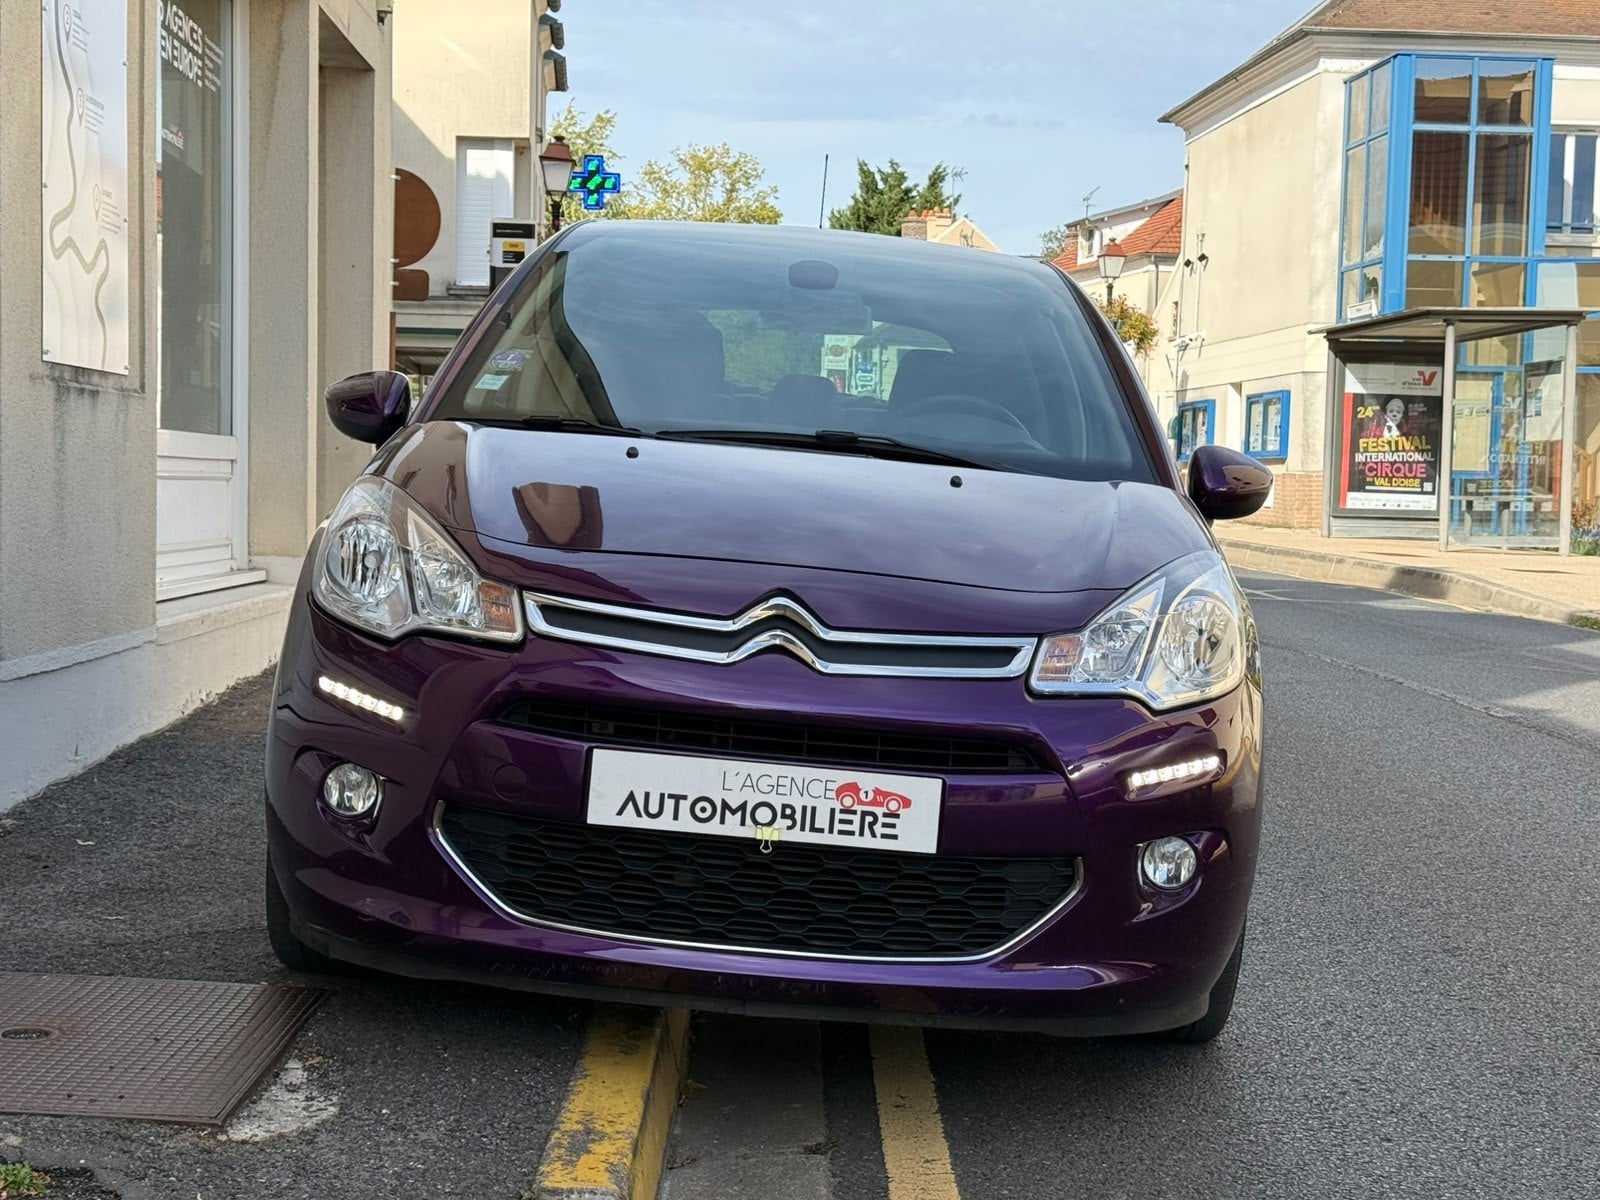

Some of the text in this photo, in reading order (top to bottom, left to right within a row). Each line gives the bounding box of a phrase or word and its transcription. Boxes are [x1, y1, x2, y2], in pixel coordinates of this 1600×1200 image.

[166, 0, 202, 54] AGENCES
[160, 27, 172, 63] EN
[173, 39, 202, 88] EUROPE
[1359, 435, 1431, 452] FESTIVAL
[1354, 452, 1434, 462] INTERNATIONAL
[1365, 463, 1427, 478] CIRQUE
[1374, 477, 1391, 486] VAL
[1391, 478, 1421, 488] D'OISE
